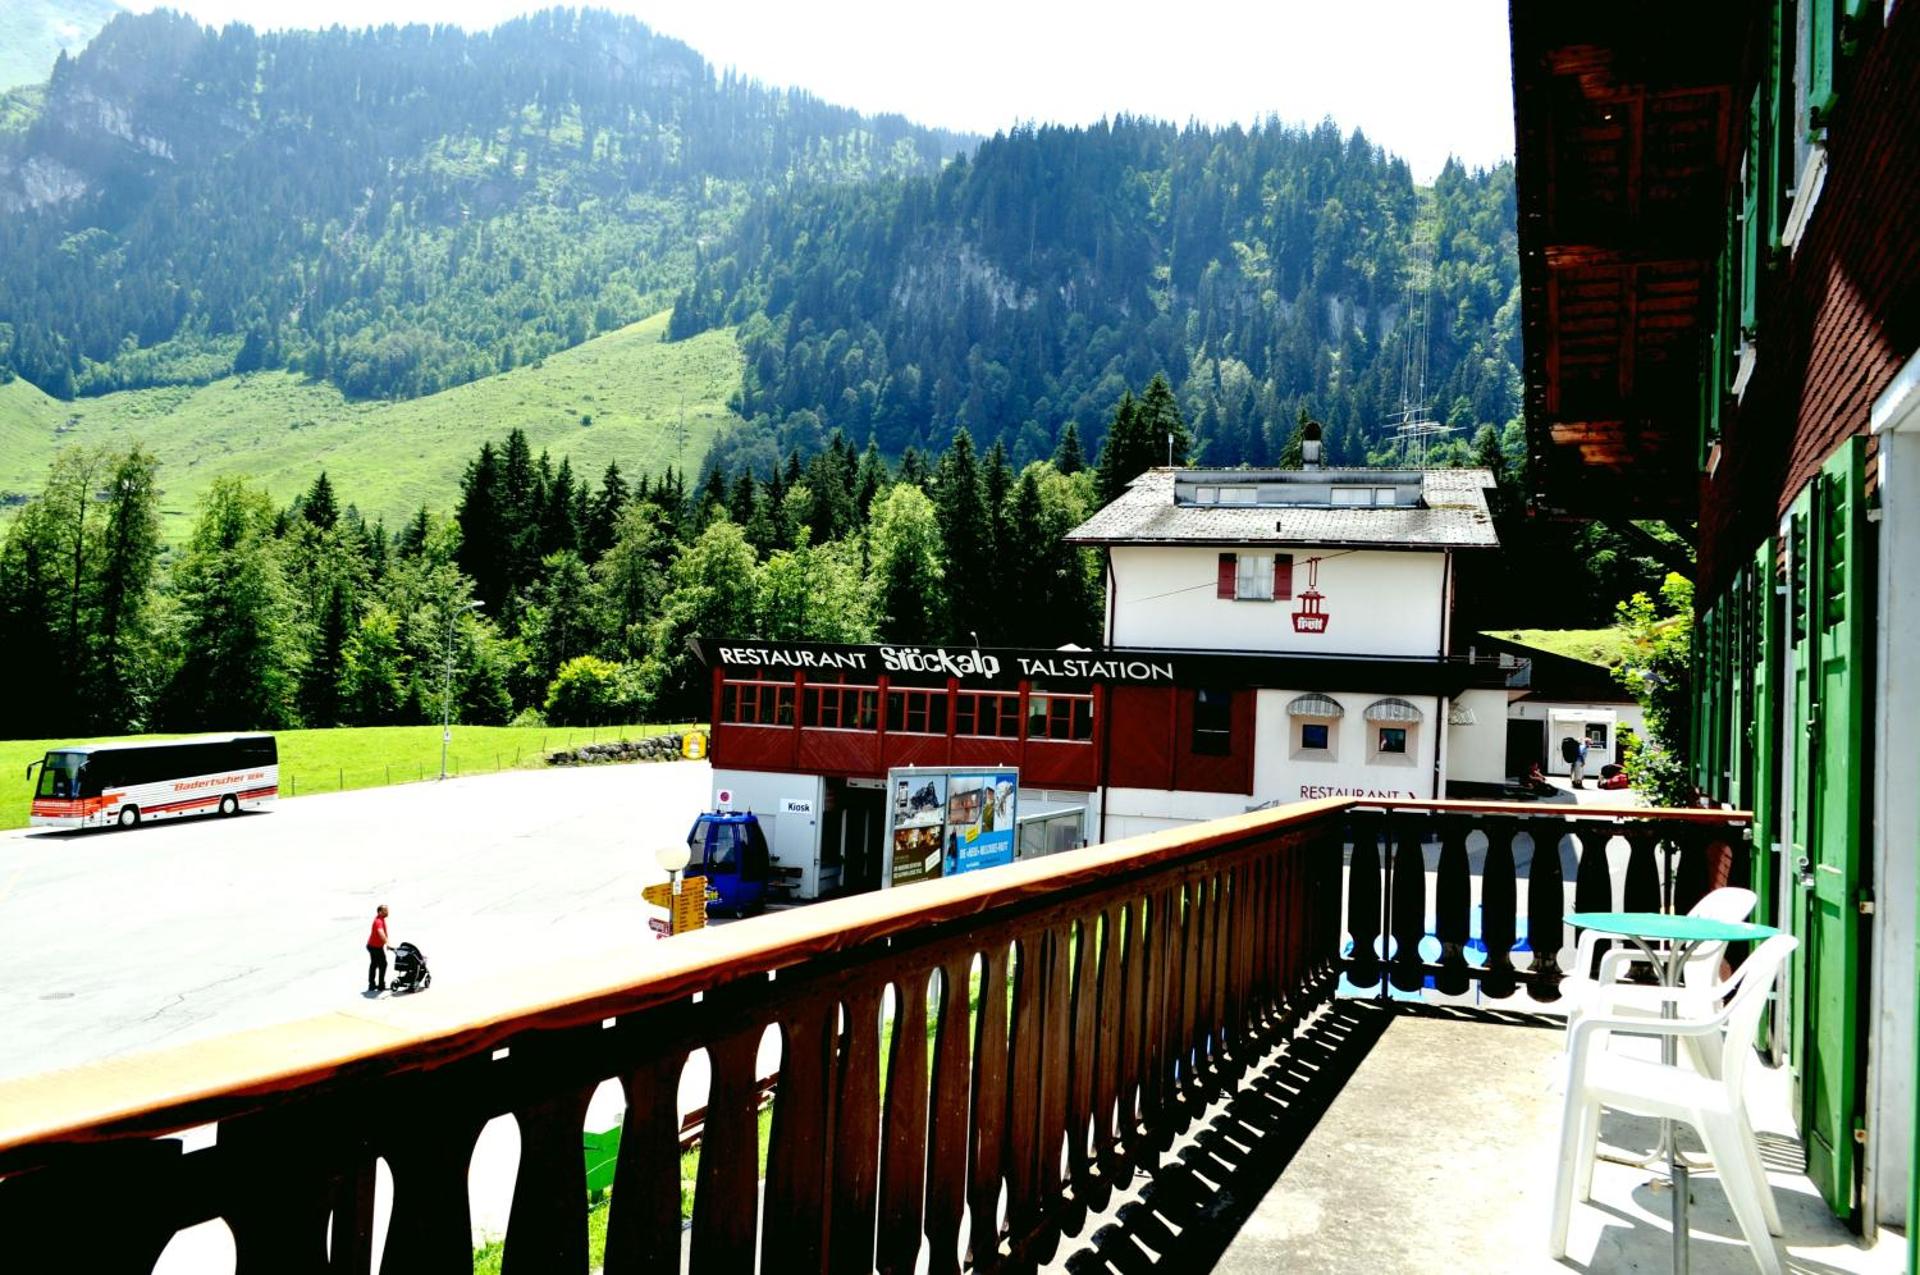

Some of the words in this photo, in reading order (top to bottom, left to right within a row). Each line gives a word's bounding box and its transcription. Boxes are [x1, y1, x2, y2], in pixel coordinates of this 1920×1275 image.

[719, 647, 867, 669] RESTAURANT
[880, 646, 1001, 679] Stöckalp
[1017, 658, 1174, 680] TALSTATION
[787, 802, 810, 813] Kiosk
